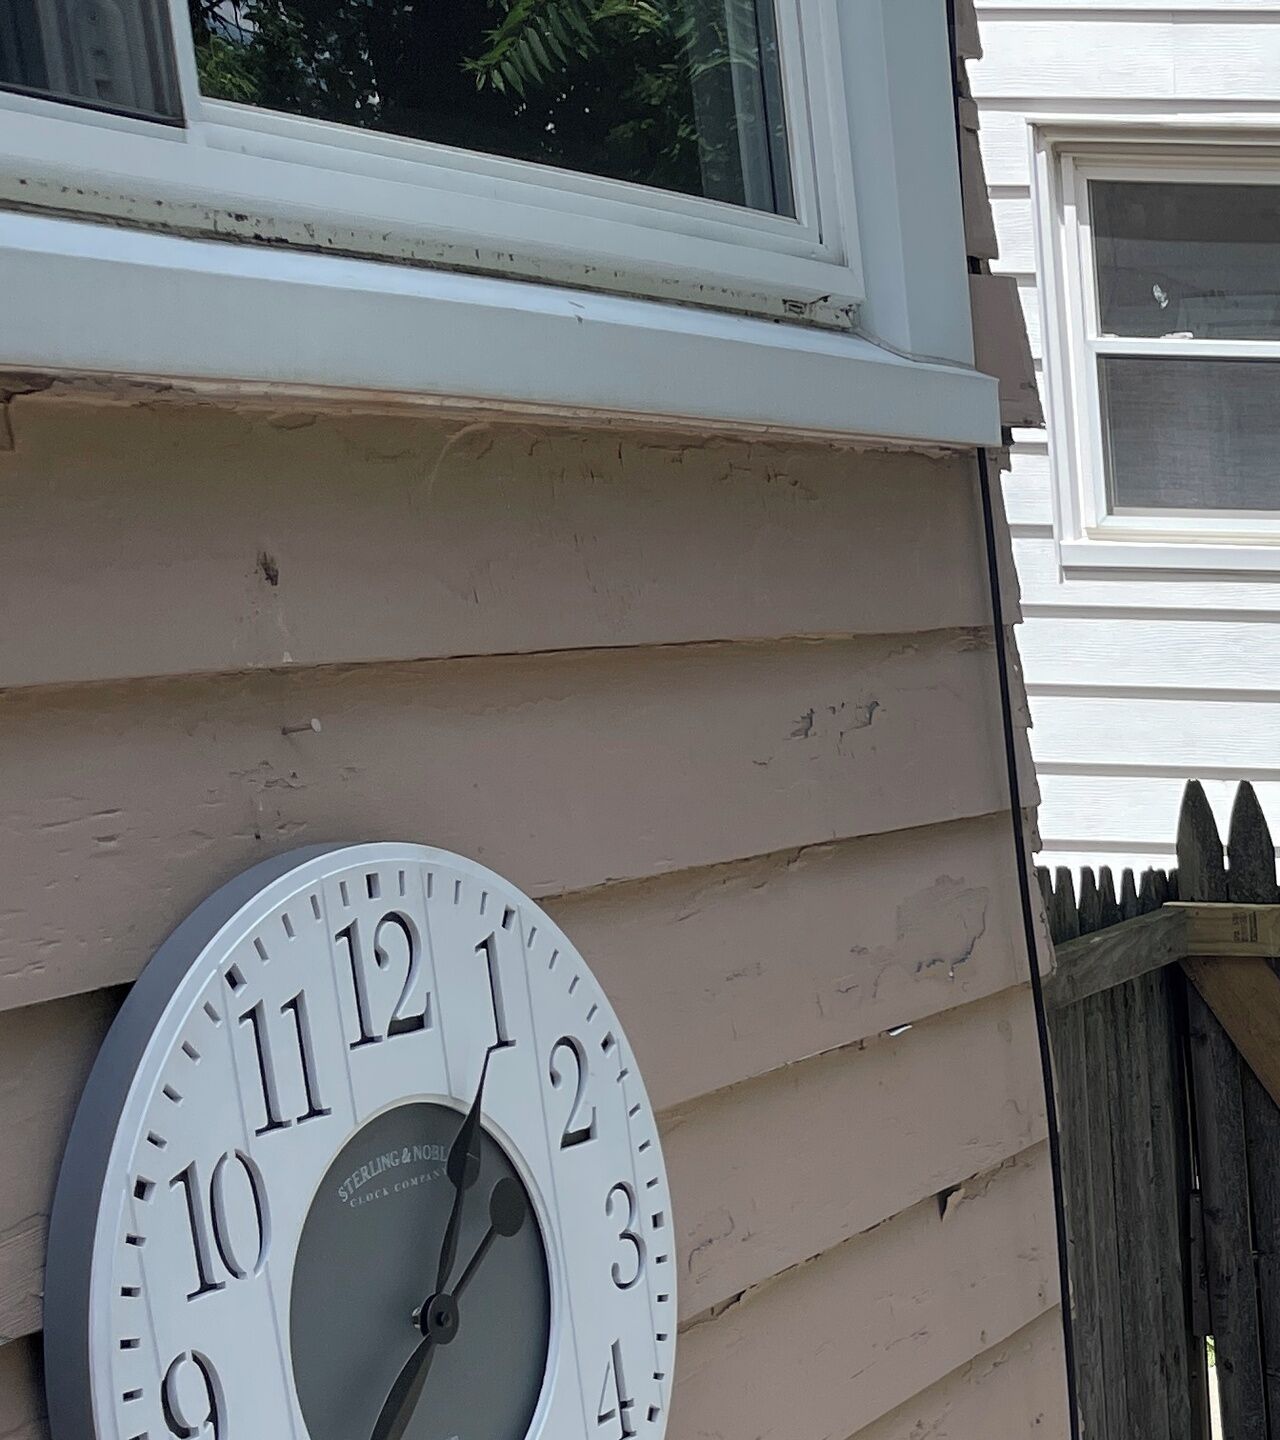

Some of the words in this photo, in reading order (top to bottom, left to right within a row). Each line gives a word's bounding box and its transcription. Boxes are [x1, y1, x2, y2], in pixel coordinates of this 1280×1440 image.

[334, 911, 432, 1051] 12
[475, 931, 516, 1049] 1
[239, 989, 331, 1135] 11
[549, 1035, 598, 1149] 2
[170, 1148, 266, 1302] 10
[338, 1150, 400, 1202] STERLING
[413, 1145, 450, 1162] NOBL
[350, 1187, 390, 1208] CLOCK
[394, 1167, 449, 1192] COMPANY
[606, 1181, 646, 1289] 3
